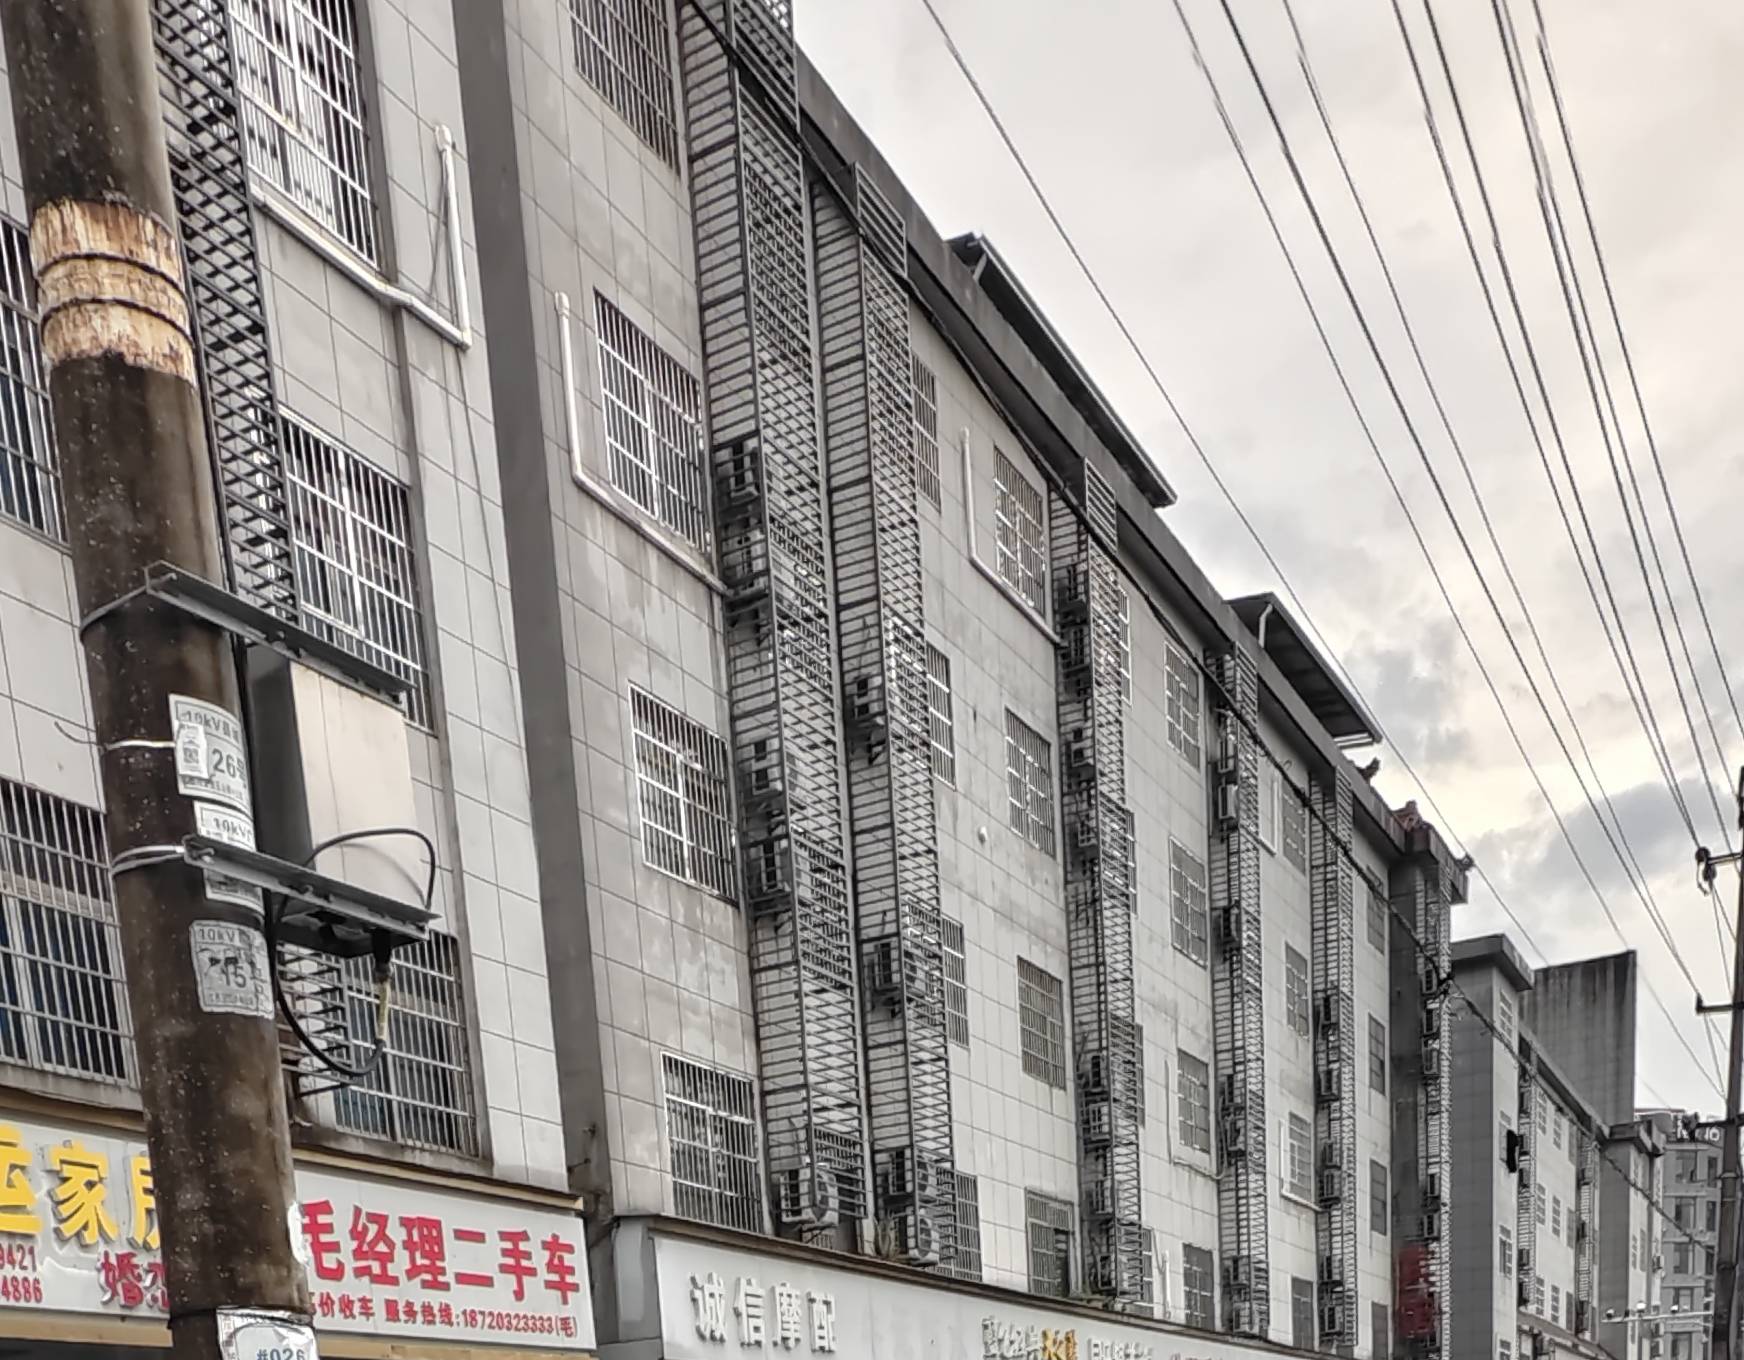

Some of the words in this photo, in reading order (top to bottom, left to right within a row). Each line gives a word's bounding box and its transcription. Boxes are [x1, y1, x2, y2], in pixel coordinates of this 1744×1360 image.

[300, 1199, 580, 1305] 毛经理二手车
[689, 1271, 837, 1353] 诚信摩配
